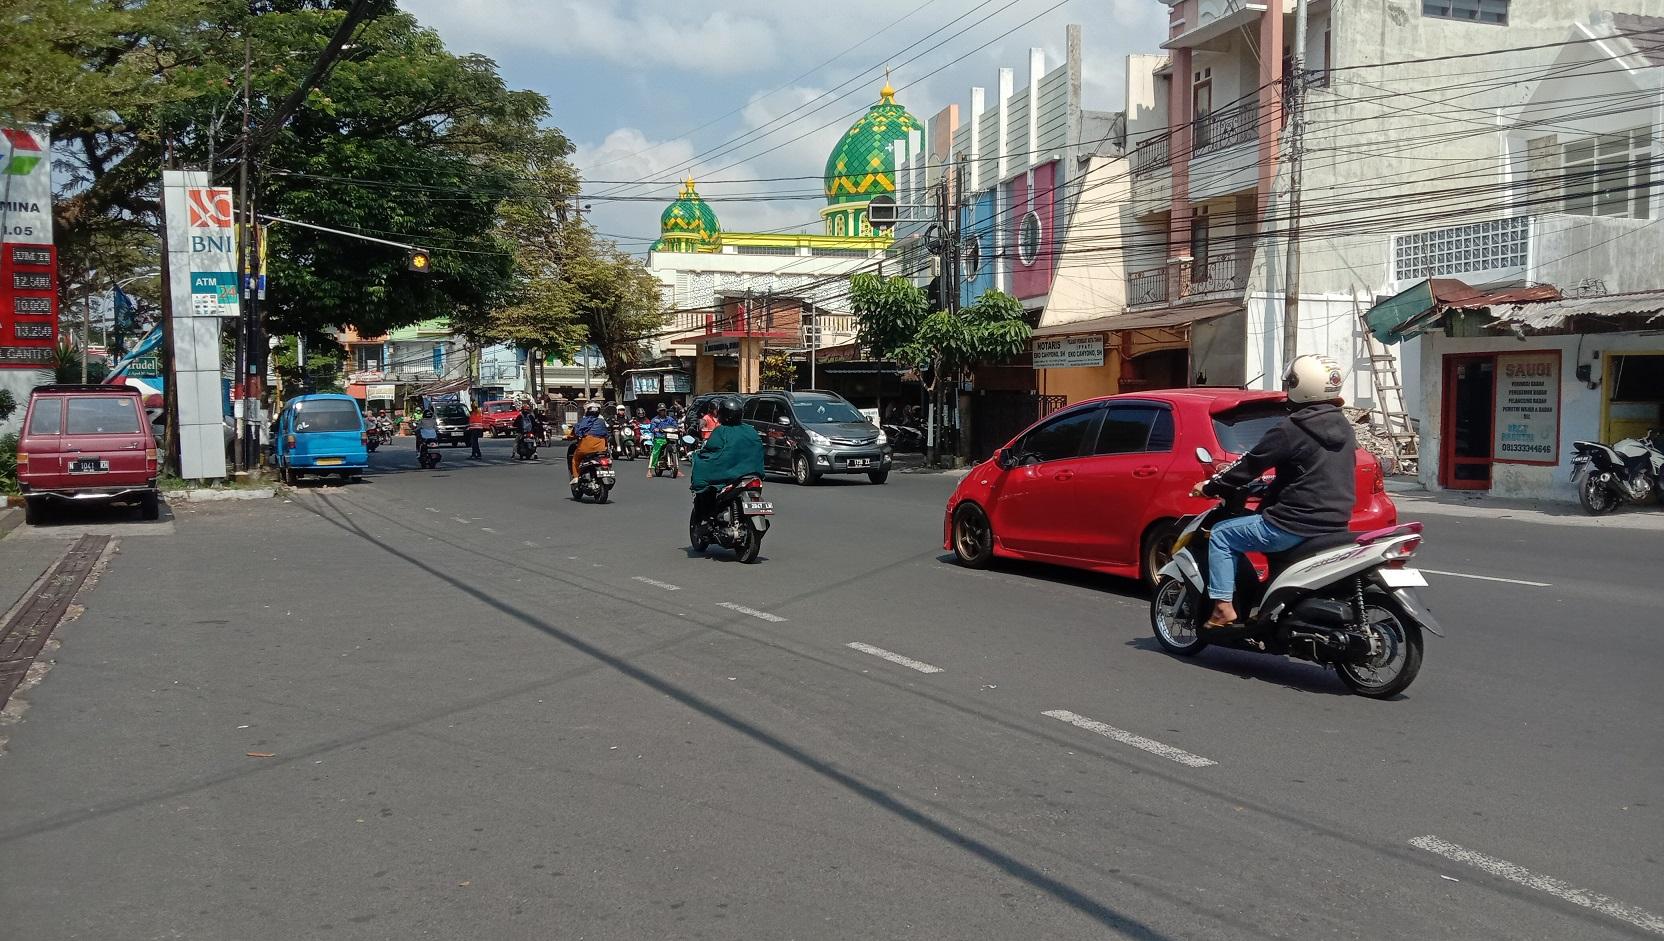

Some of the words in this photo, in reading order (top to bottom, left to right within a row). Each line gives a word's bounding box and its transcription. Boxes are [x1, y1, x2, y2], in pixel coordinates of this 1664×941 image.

[192, 236, 231, 252] BNI
[195, 278, 217, 286] ATM
[1037, 341, 1061, 351] NOTARIS
